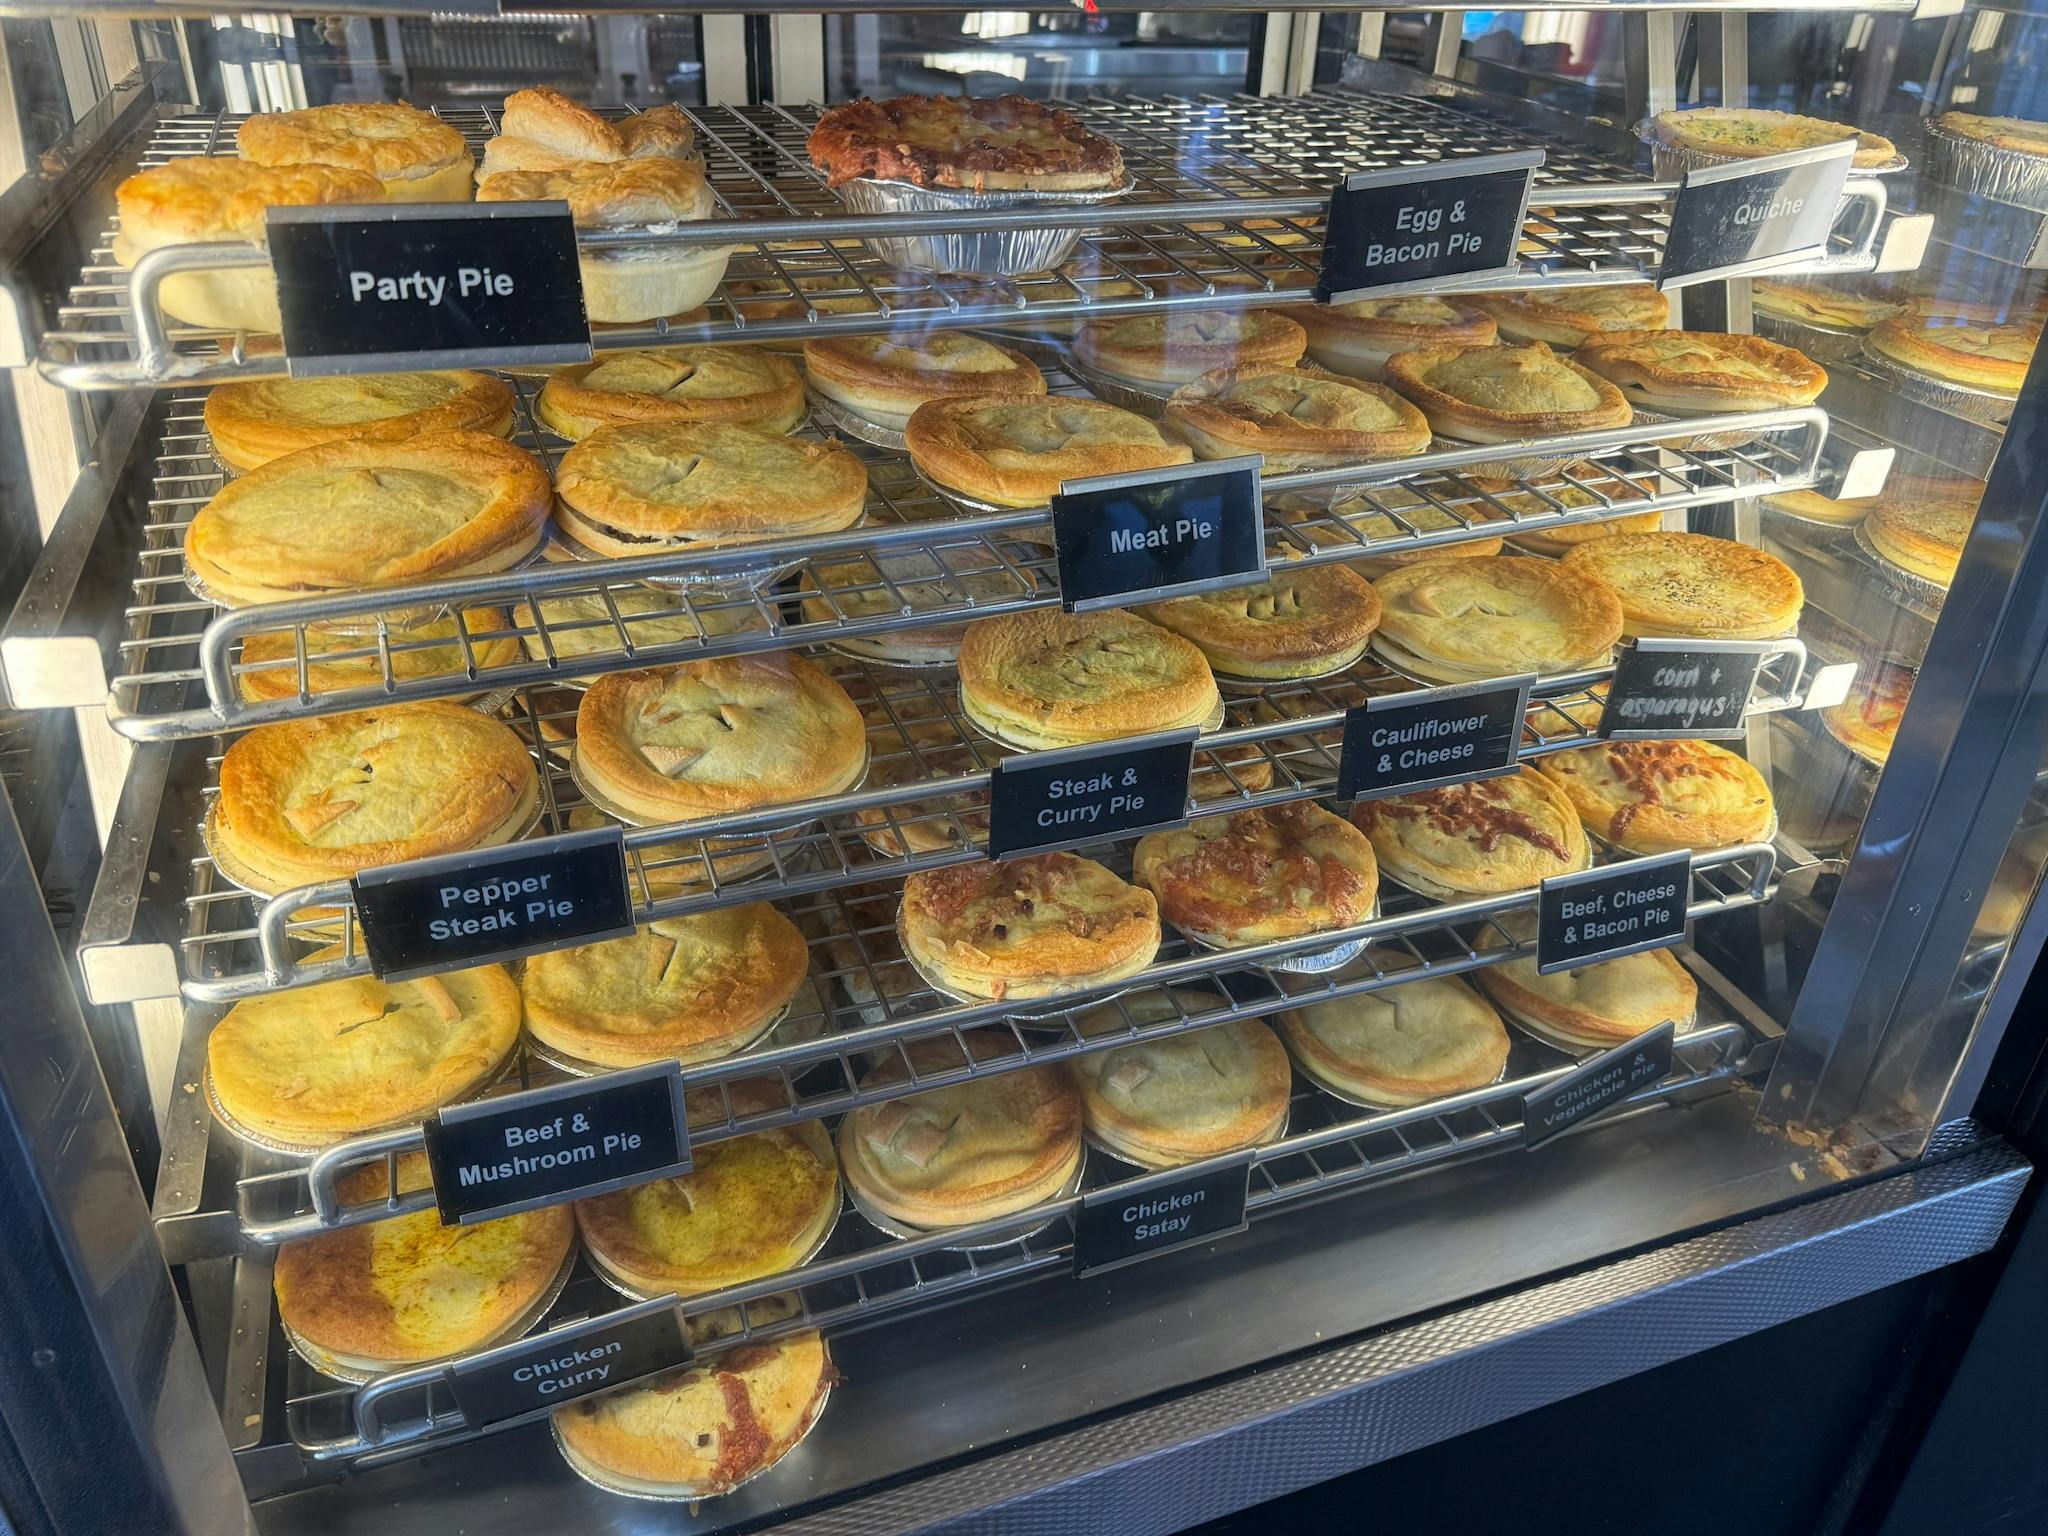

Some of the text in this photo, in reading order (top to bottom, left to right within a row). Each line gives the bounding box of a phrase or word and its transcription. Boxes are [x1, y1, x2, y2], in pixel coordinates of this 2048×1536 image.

[1396, 200, 1467, 234] Egg &
[1733, 197, 1804, 225] Quiche
[1365, 232, 1483, 267] Bacon Pie
[350, 267, 515, 306] Party Pie
[1110, 518, 1213, 554] Meat Pie
[1620, 695, 1727, 728] asparagus
[1371, 714, 1489, 748] Cauliflower
[1376, 743, 1475, 773] & Cheese
[1048, 767, 1138, 799] Steak &
[1037, 794, 1145, 828] Curry Pie
[440, 873, 552, 908] Pepper
[1561, 884, 1676, 920] Beef, Cheese
[429, 899, 574, 940] Steak Pie
[1563, 908, 1670, 944] & Bacon Pie
[1543, 1063, 1656, 1126] Vegetable Pie
[1554, 1067, 1622, 1107] Chicken
[504, 1113, 591, 1148] Beef &
[458, 1132, 642, 1187] Mushroom Pie
[1122, 1190, 1205, 1223] Chicken
[1134, 1214, 1191, 1240] Satay
[513, 1341, 622, 1381] Chicken
[537, 1363, 611, 1394] Curry
